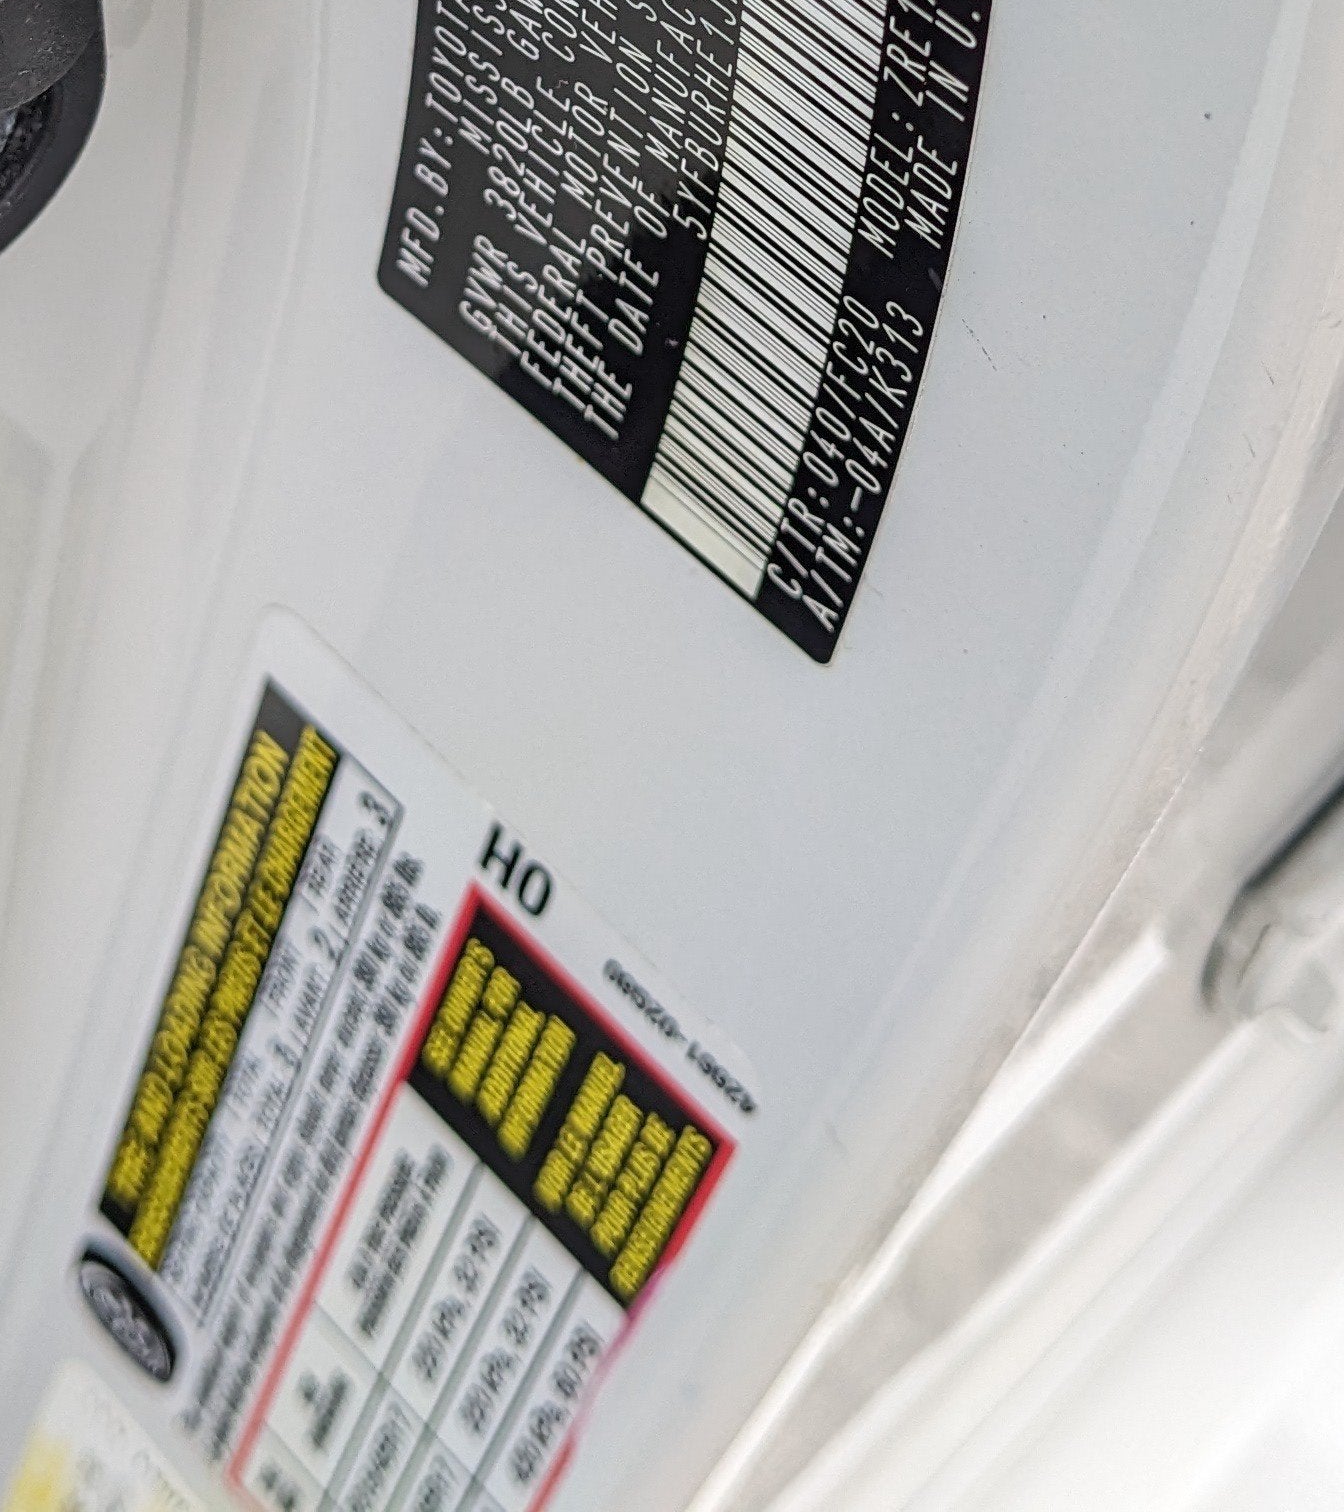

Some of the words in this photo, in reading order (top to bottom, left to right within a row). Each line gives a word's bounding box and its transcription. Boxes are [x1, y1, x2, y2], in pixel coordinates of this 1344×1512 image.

[925, 60, 970, 122] IN
[488, 261, 538, 356] THIS
[514, 76, 570, 246] VEHICLE
[519, 227, 586, 387] FEDERAL
[560, 82, 609, 208] MOTOR
[552, 289, 609, 410] THEFT
[586, 36, 652, 283] PREVENTION
[633, 180, 671, 238] OF
[904, 134, 958, 249] MADE
[459, 235, 509, 334] GVWR
[608, 248, 660, 356] DATE
[583, 359, 633, 439] THE
[189, 724, 292, 963] INFORMATION
[255, 721, 340, 903] CHARGEMENT
